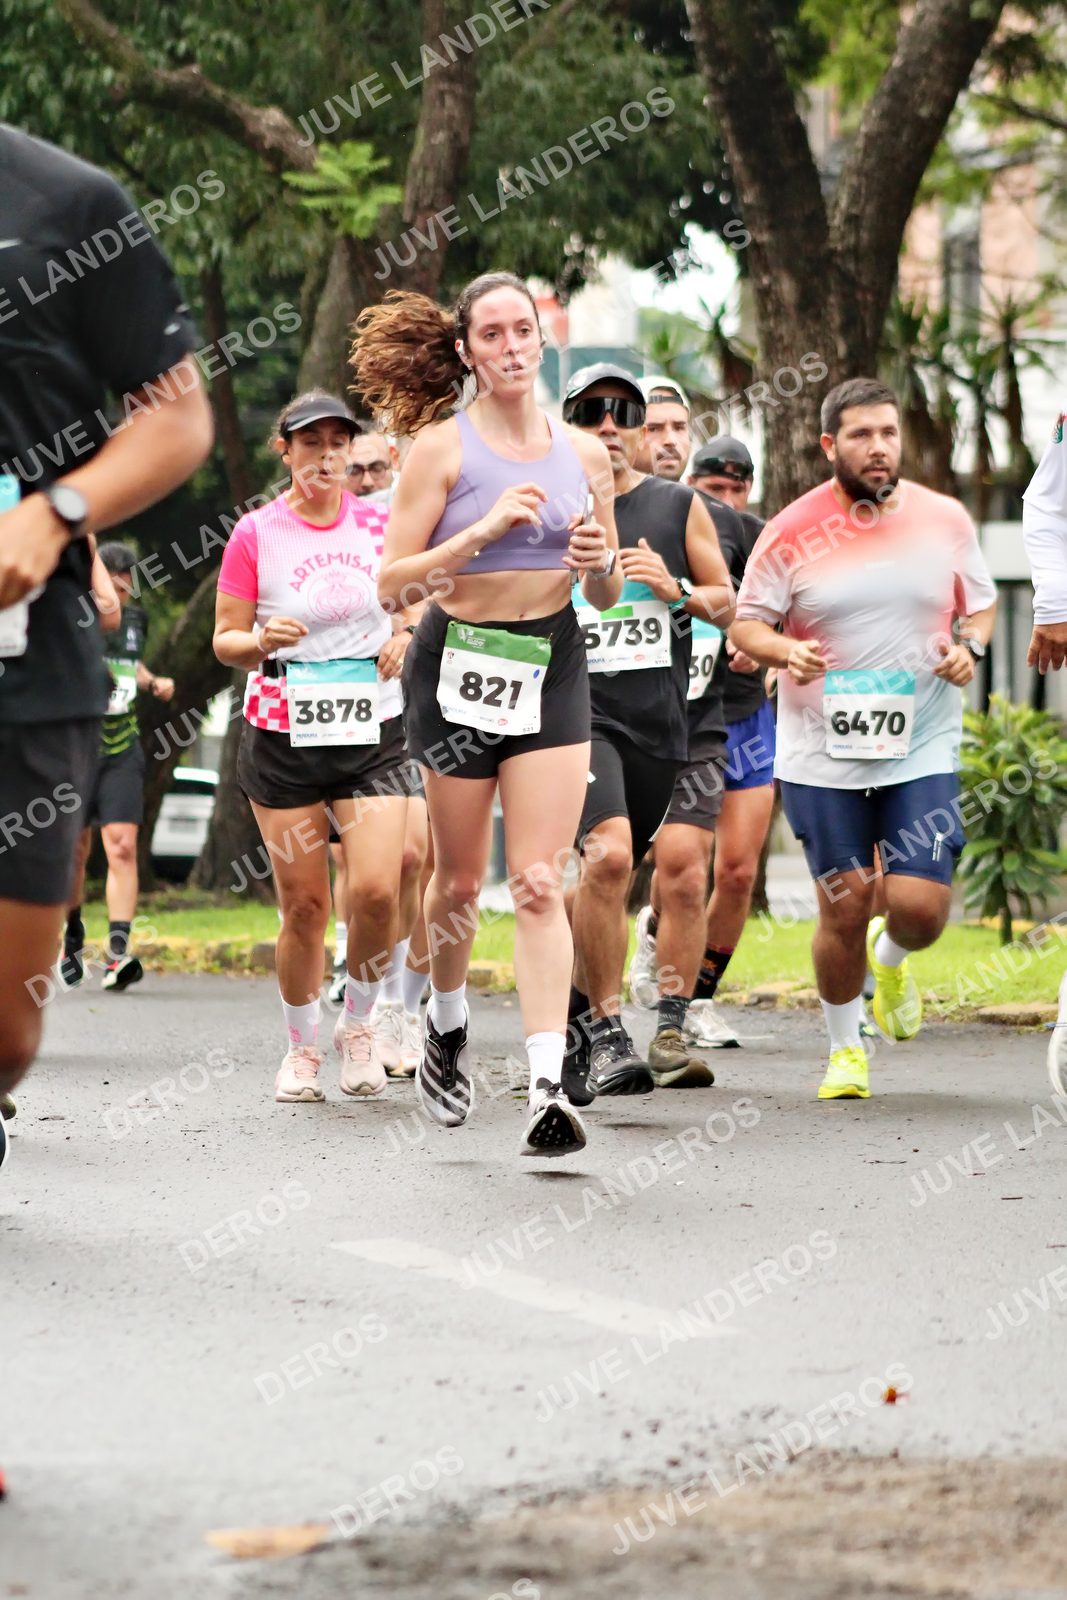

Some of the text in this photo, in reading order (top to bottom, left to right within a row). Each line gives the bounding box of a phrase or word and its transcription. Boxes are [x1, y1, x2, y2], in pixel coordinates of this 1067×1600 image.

[581, 617, 662, 650] 5739
[459, 671, 523, 710] 821
[295, 699, 373, 725] 3878
[831, 711, 906, 736] 6470
